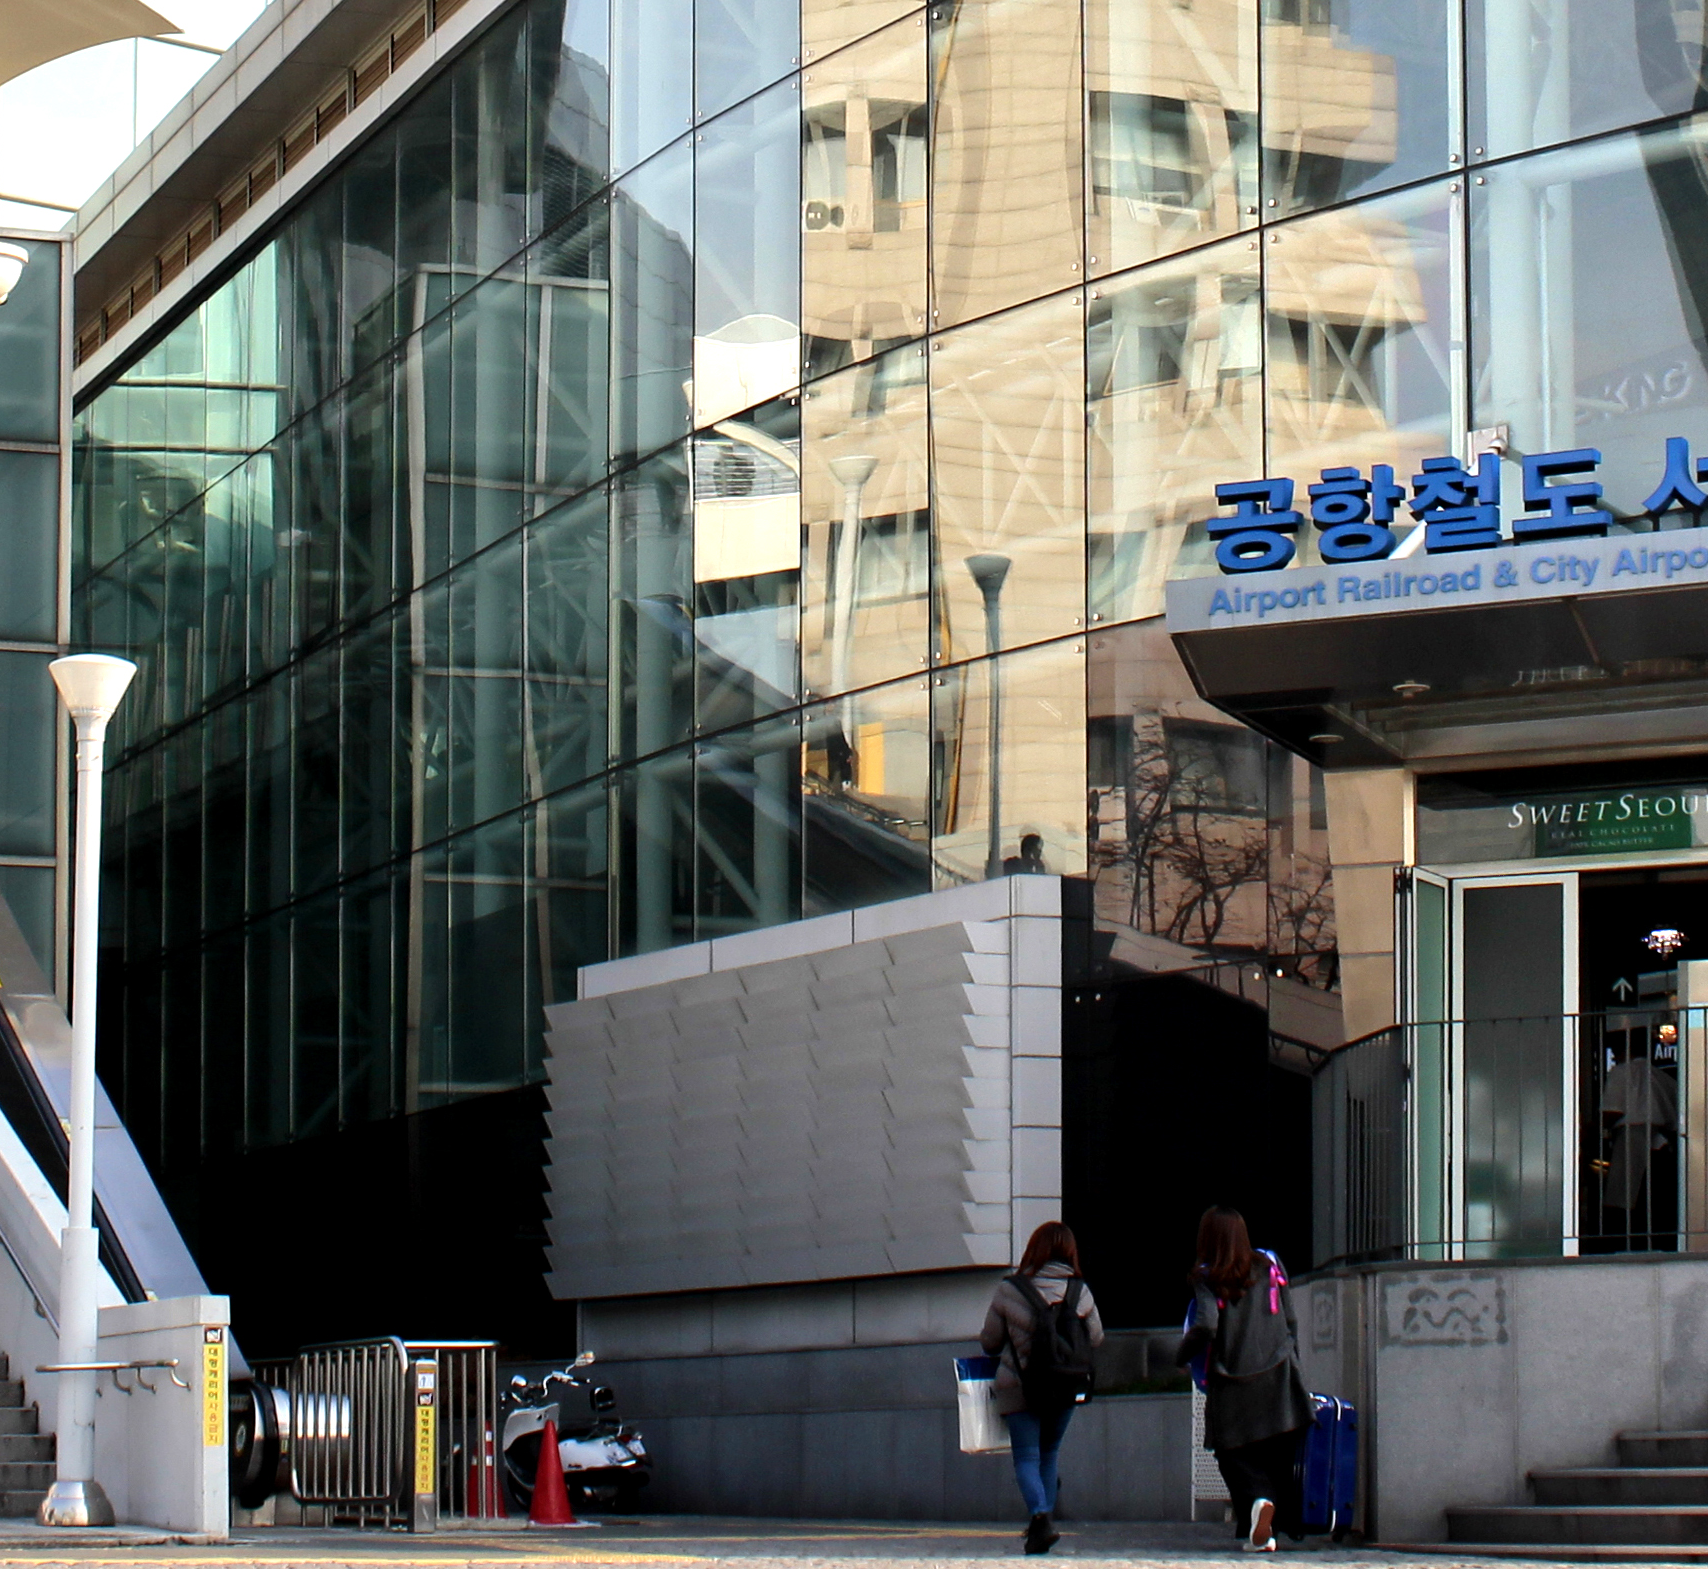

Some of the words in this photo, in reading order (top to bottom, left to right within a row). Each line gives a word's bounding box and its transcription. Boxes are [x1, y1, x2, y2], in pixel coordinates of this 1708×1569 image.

[1207, 448, 1612, 572] 공항철도
[1209, 579, 1326, 617] Airport
[1337, 562, 1482, 602] Railroad
[1493, 557, 1518, 587] &
[1530, 552, 1599, 591] City
[1590, 824, 1675, 837] CHOCOLATE
